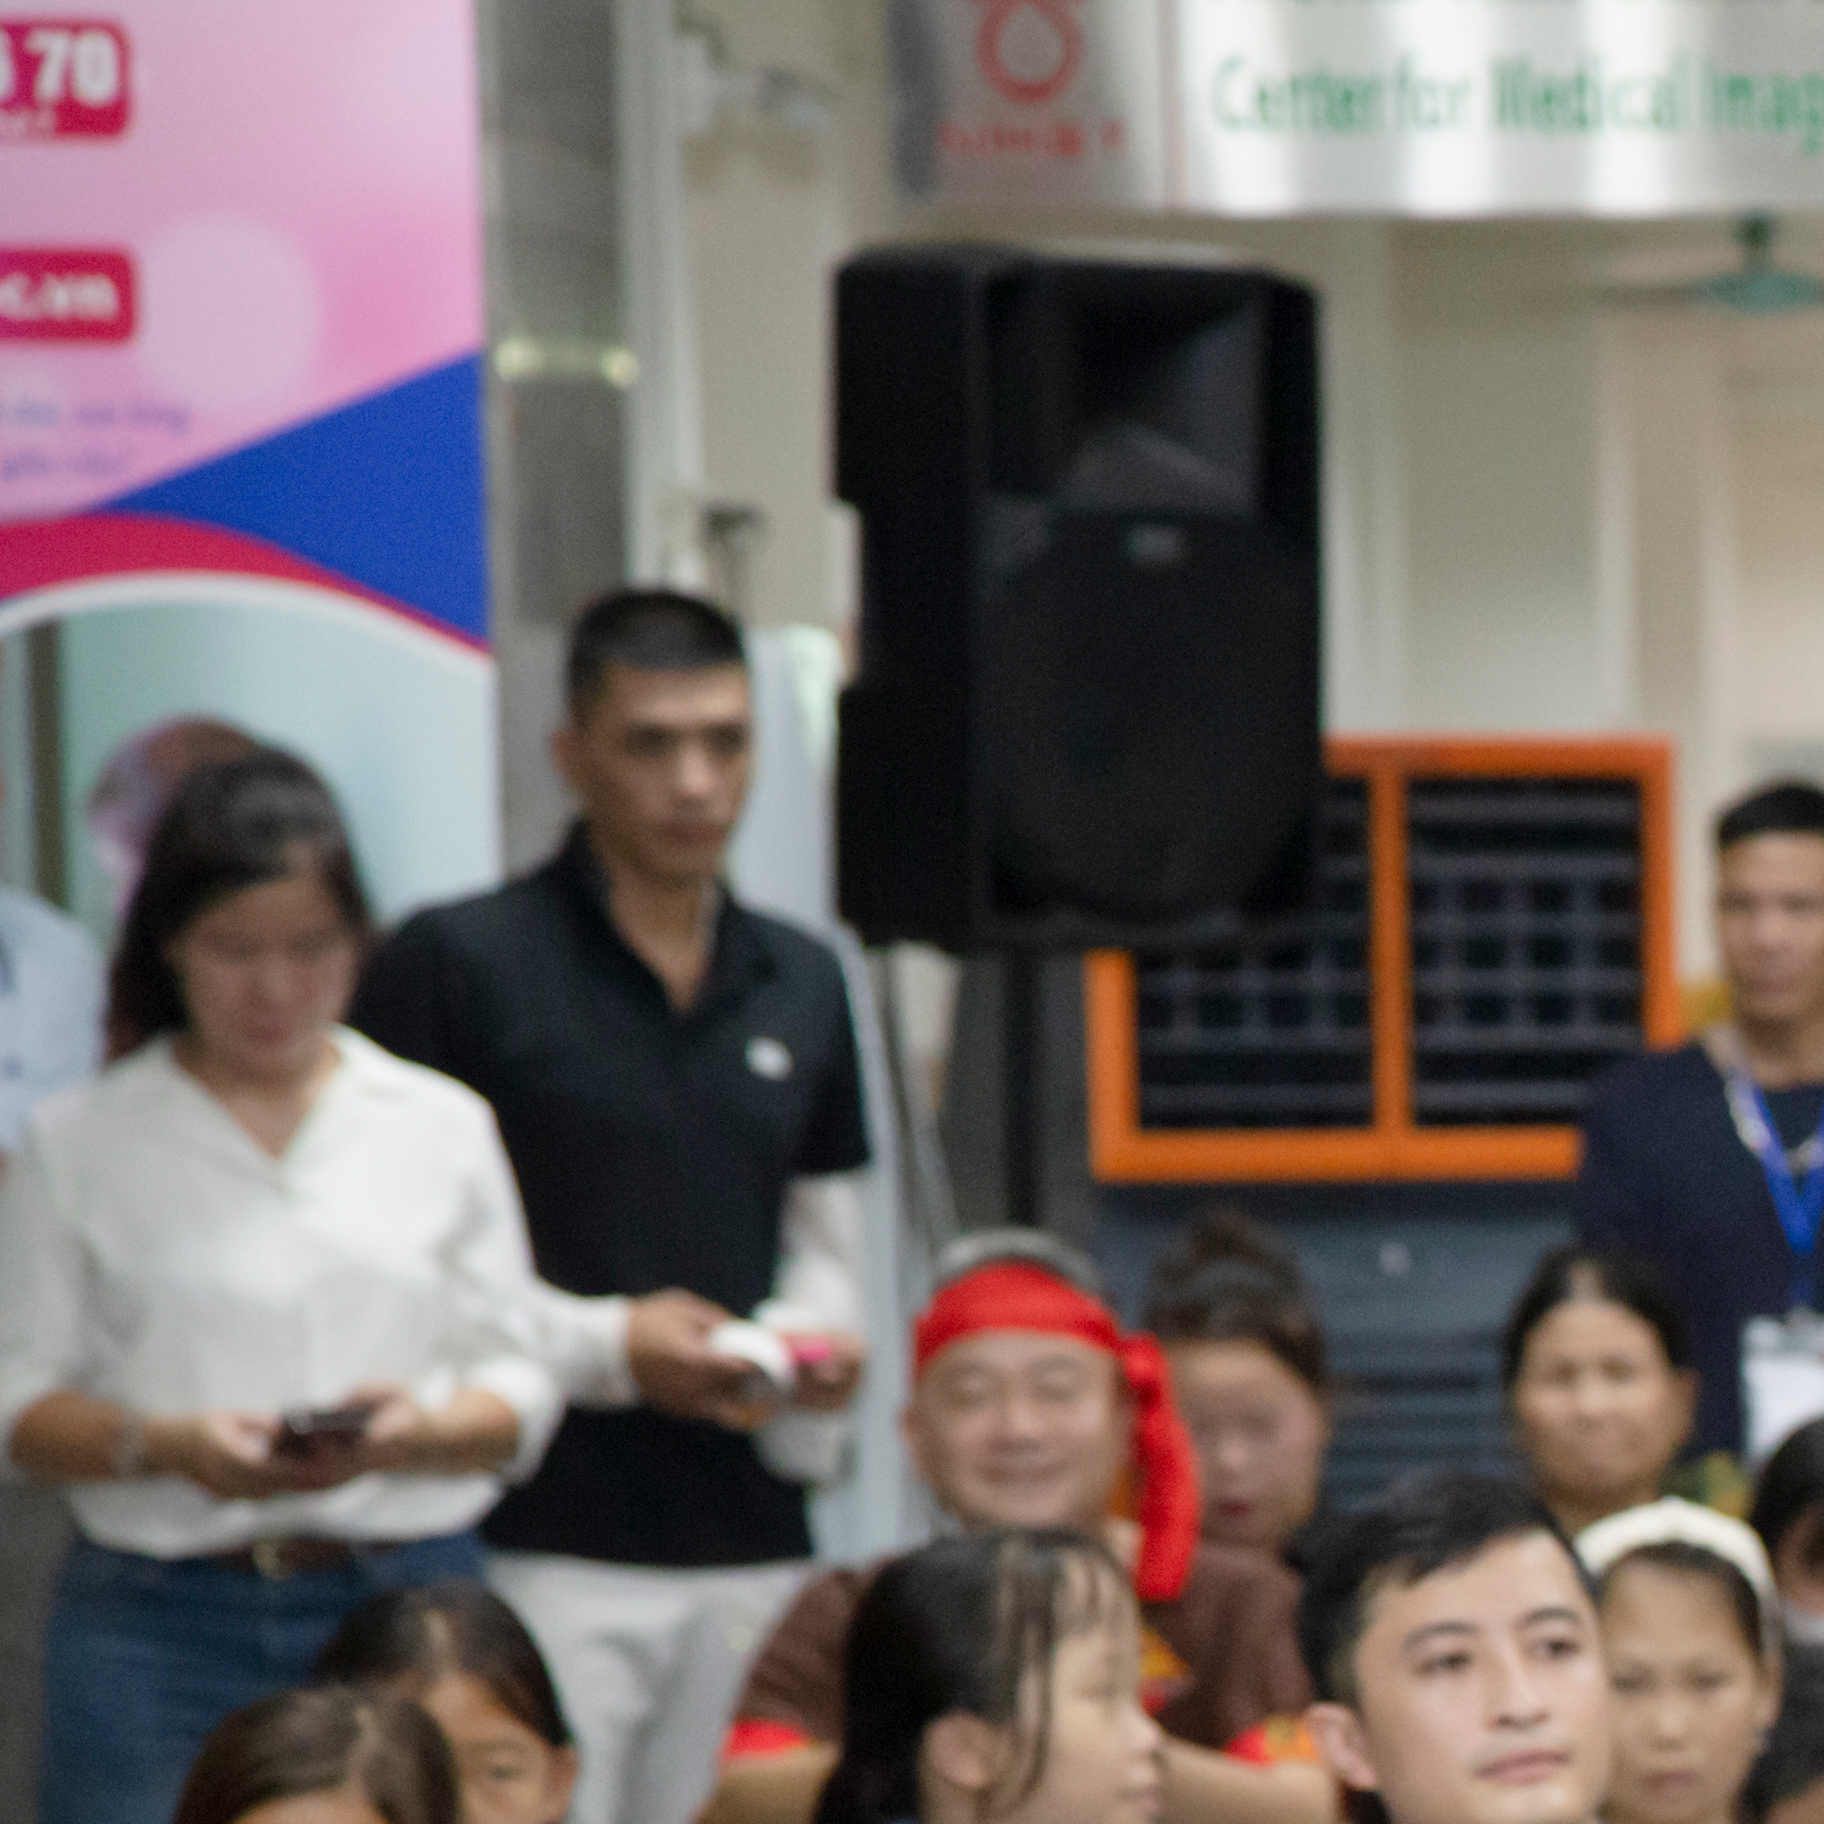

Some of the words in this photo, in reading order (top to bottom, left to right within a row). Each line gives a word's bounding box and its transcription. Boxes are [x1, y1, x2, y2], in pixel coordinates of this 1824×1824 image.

[26, 28, 118, 102] 70
[1210, 52, 1388, 132] Center
[1396, 50, 1474, 132] for
[1488, 48, 1685, 132] Medical
